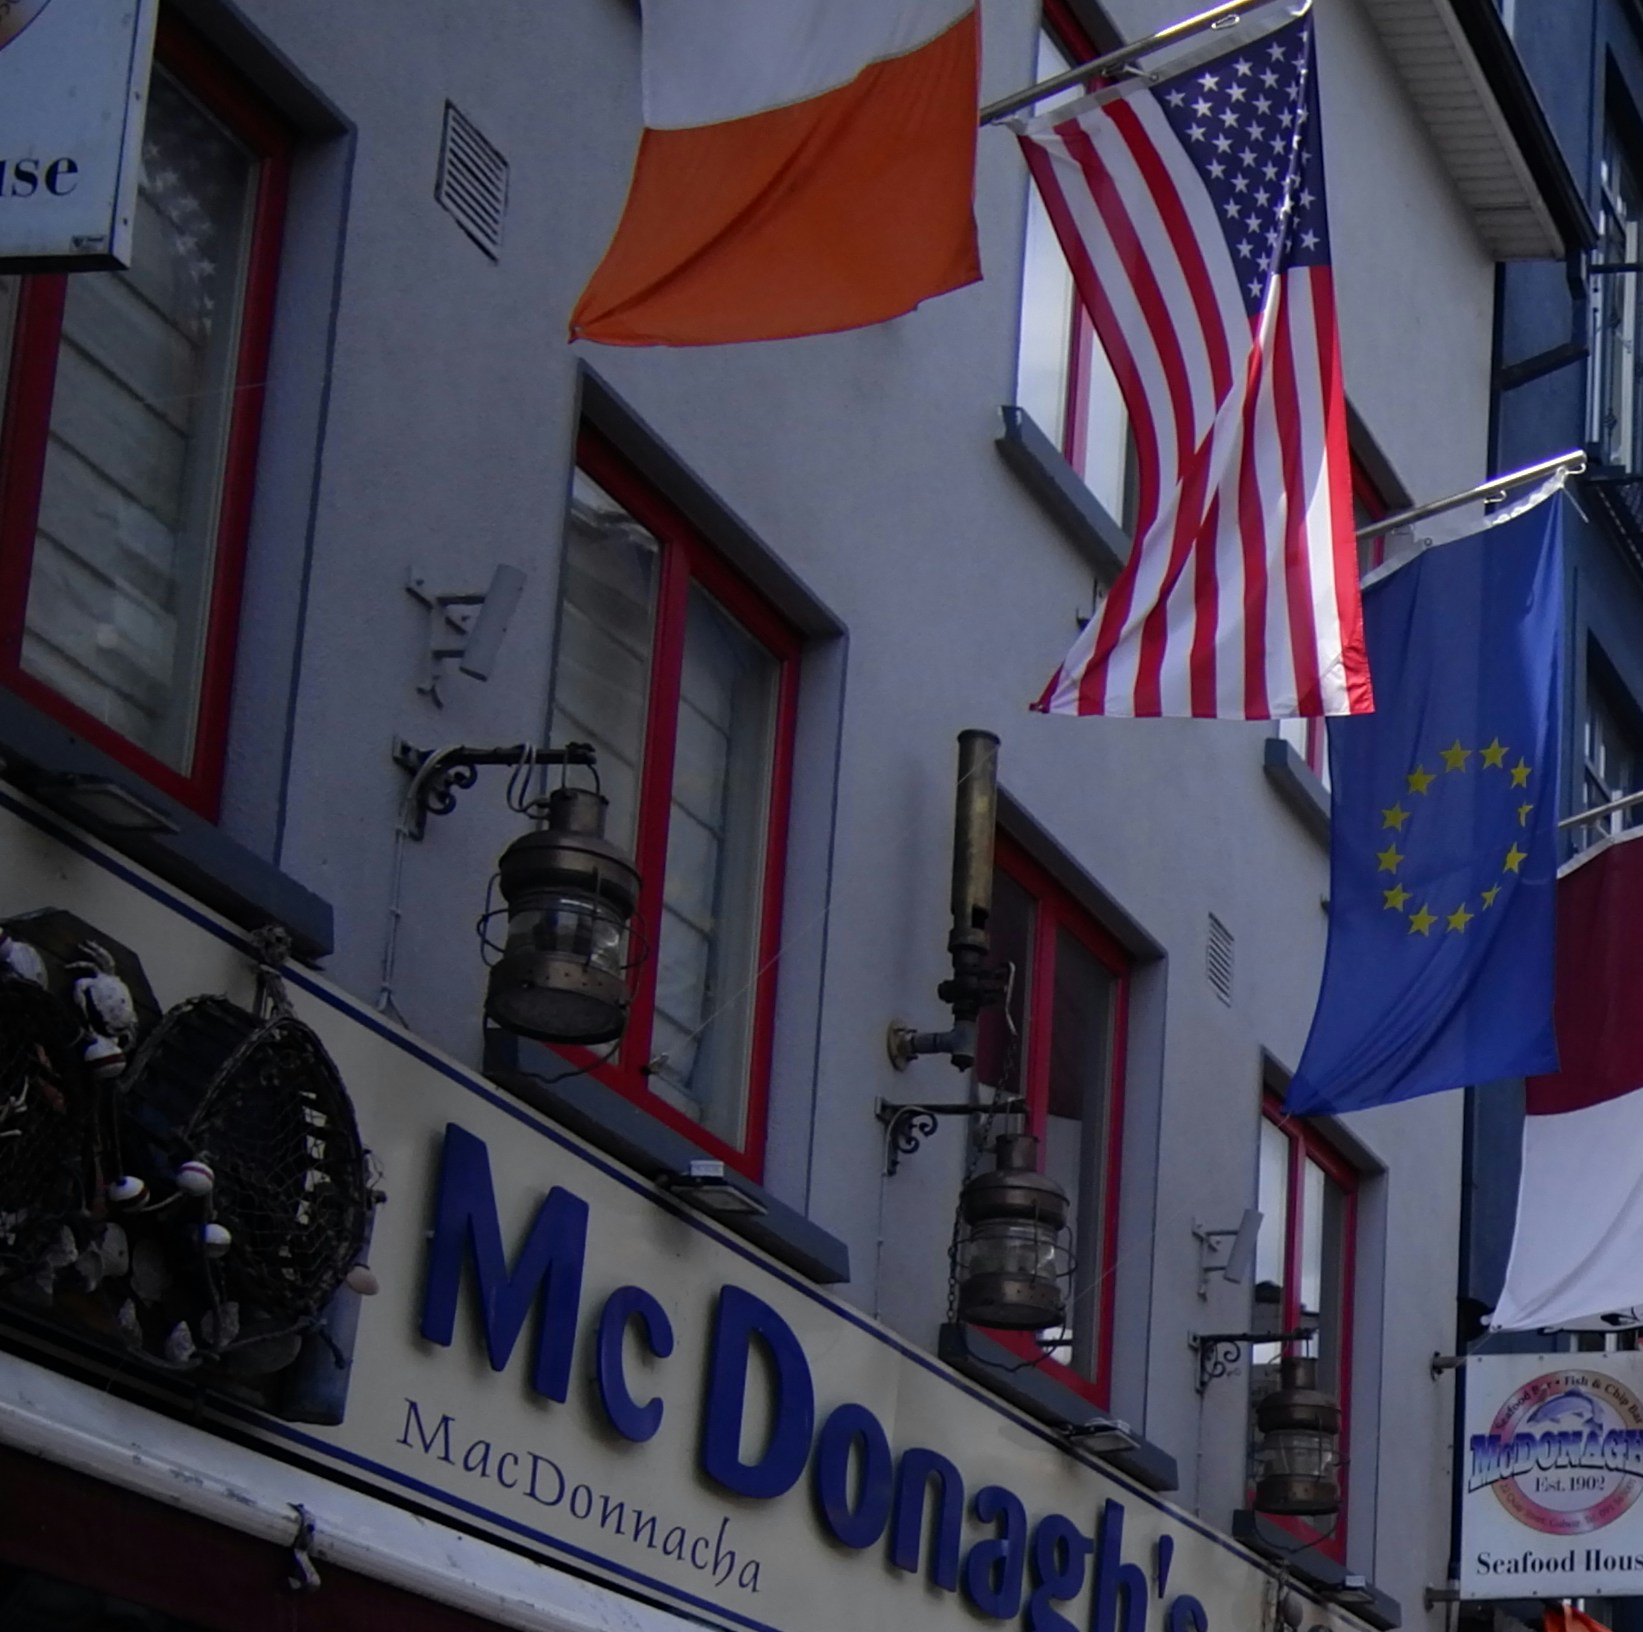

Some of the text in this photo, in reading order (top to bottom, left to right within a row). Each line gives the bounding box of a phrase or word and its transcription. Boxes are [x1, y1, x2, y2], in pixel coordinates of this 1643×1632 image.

[1564, 1375, 1589, 1387] Fish
[1592, 1378, 1601, 1389] &
[1604, 1383, 1630, 1407] Chip
[396, 1398, 762, 1593] MacDonnacha
[1535, 1476, 1606, 1492] Est. 1902
[1476, 1550, 1575, 1576] Seafood
